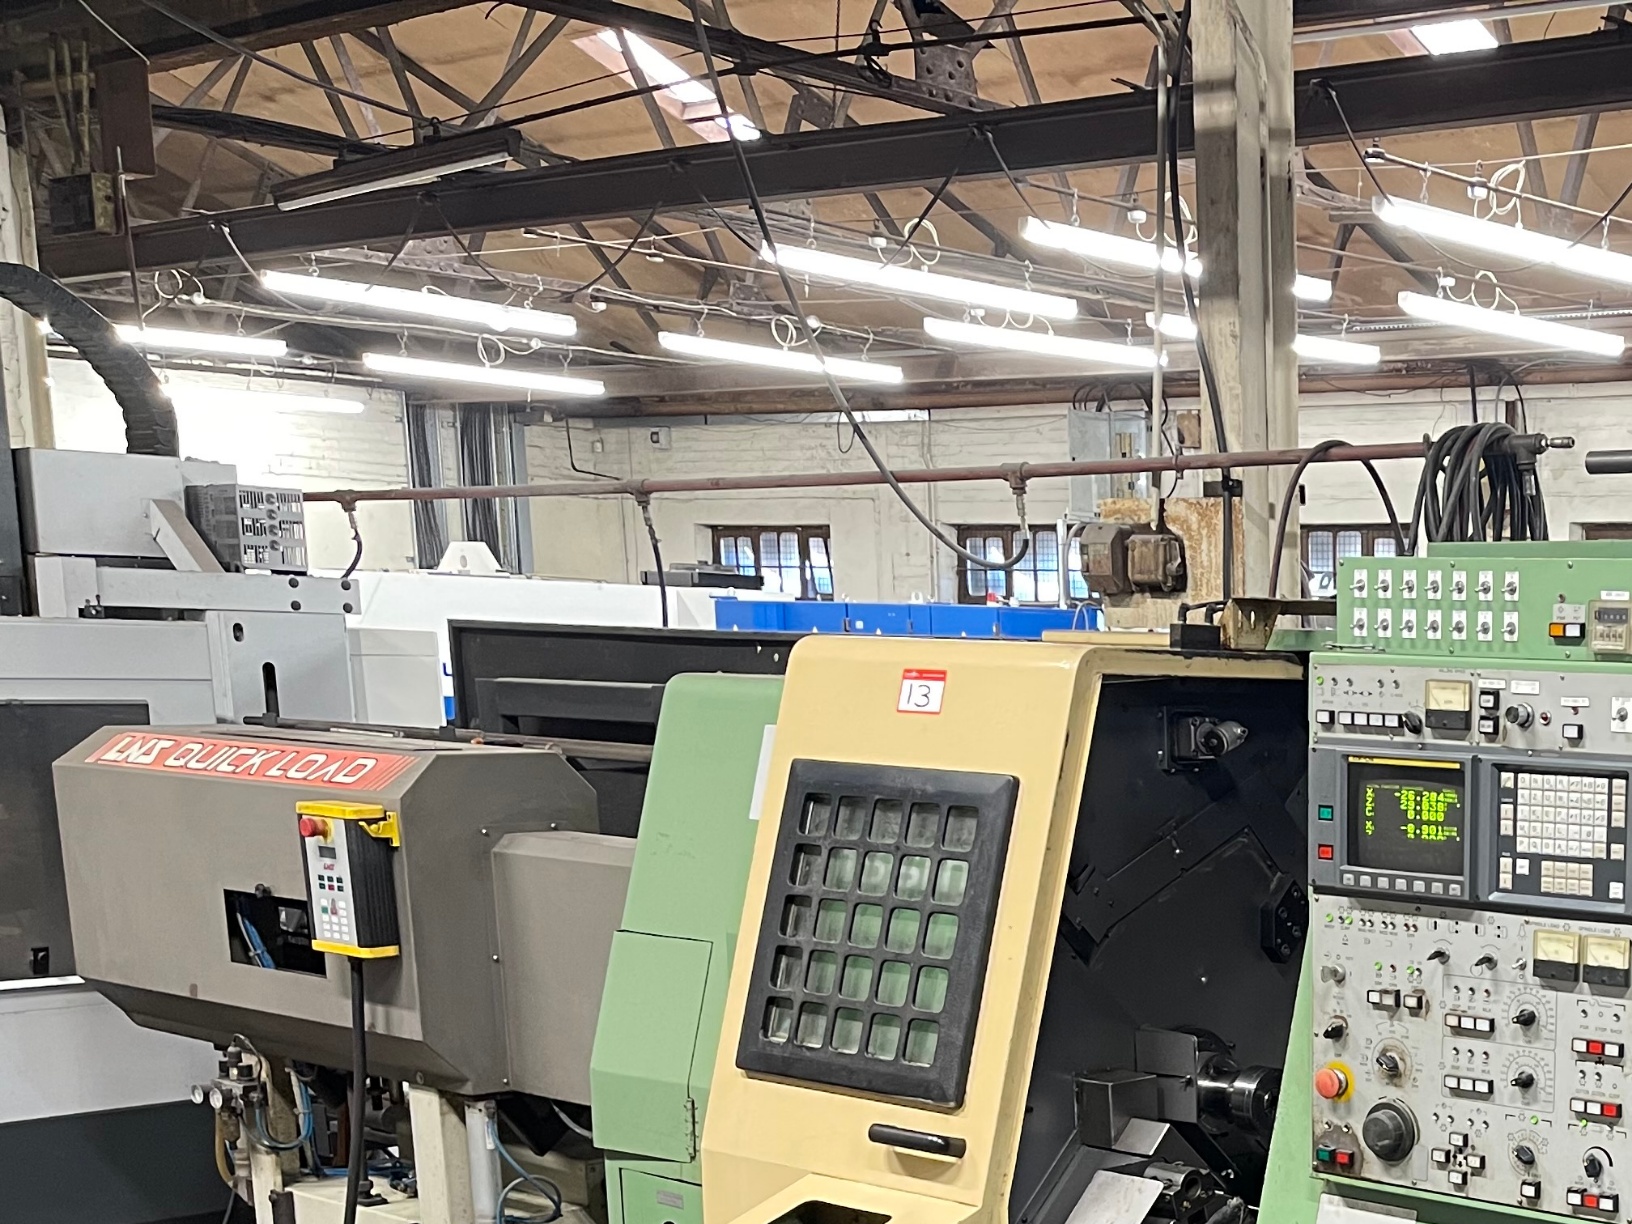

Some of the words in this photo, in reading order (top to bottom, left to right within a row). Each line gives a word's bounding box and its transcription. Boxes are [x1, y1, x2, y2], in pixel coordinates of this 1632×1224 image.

[906, 683, 931, 708] 13
[163, 742, 281, 775] QUICK
[265, 751, 378, 784] LOAD
